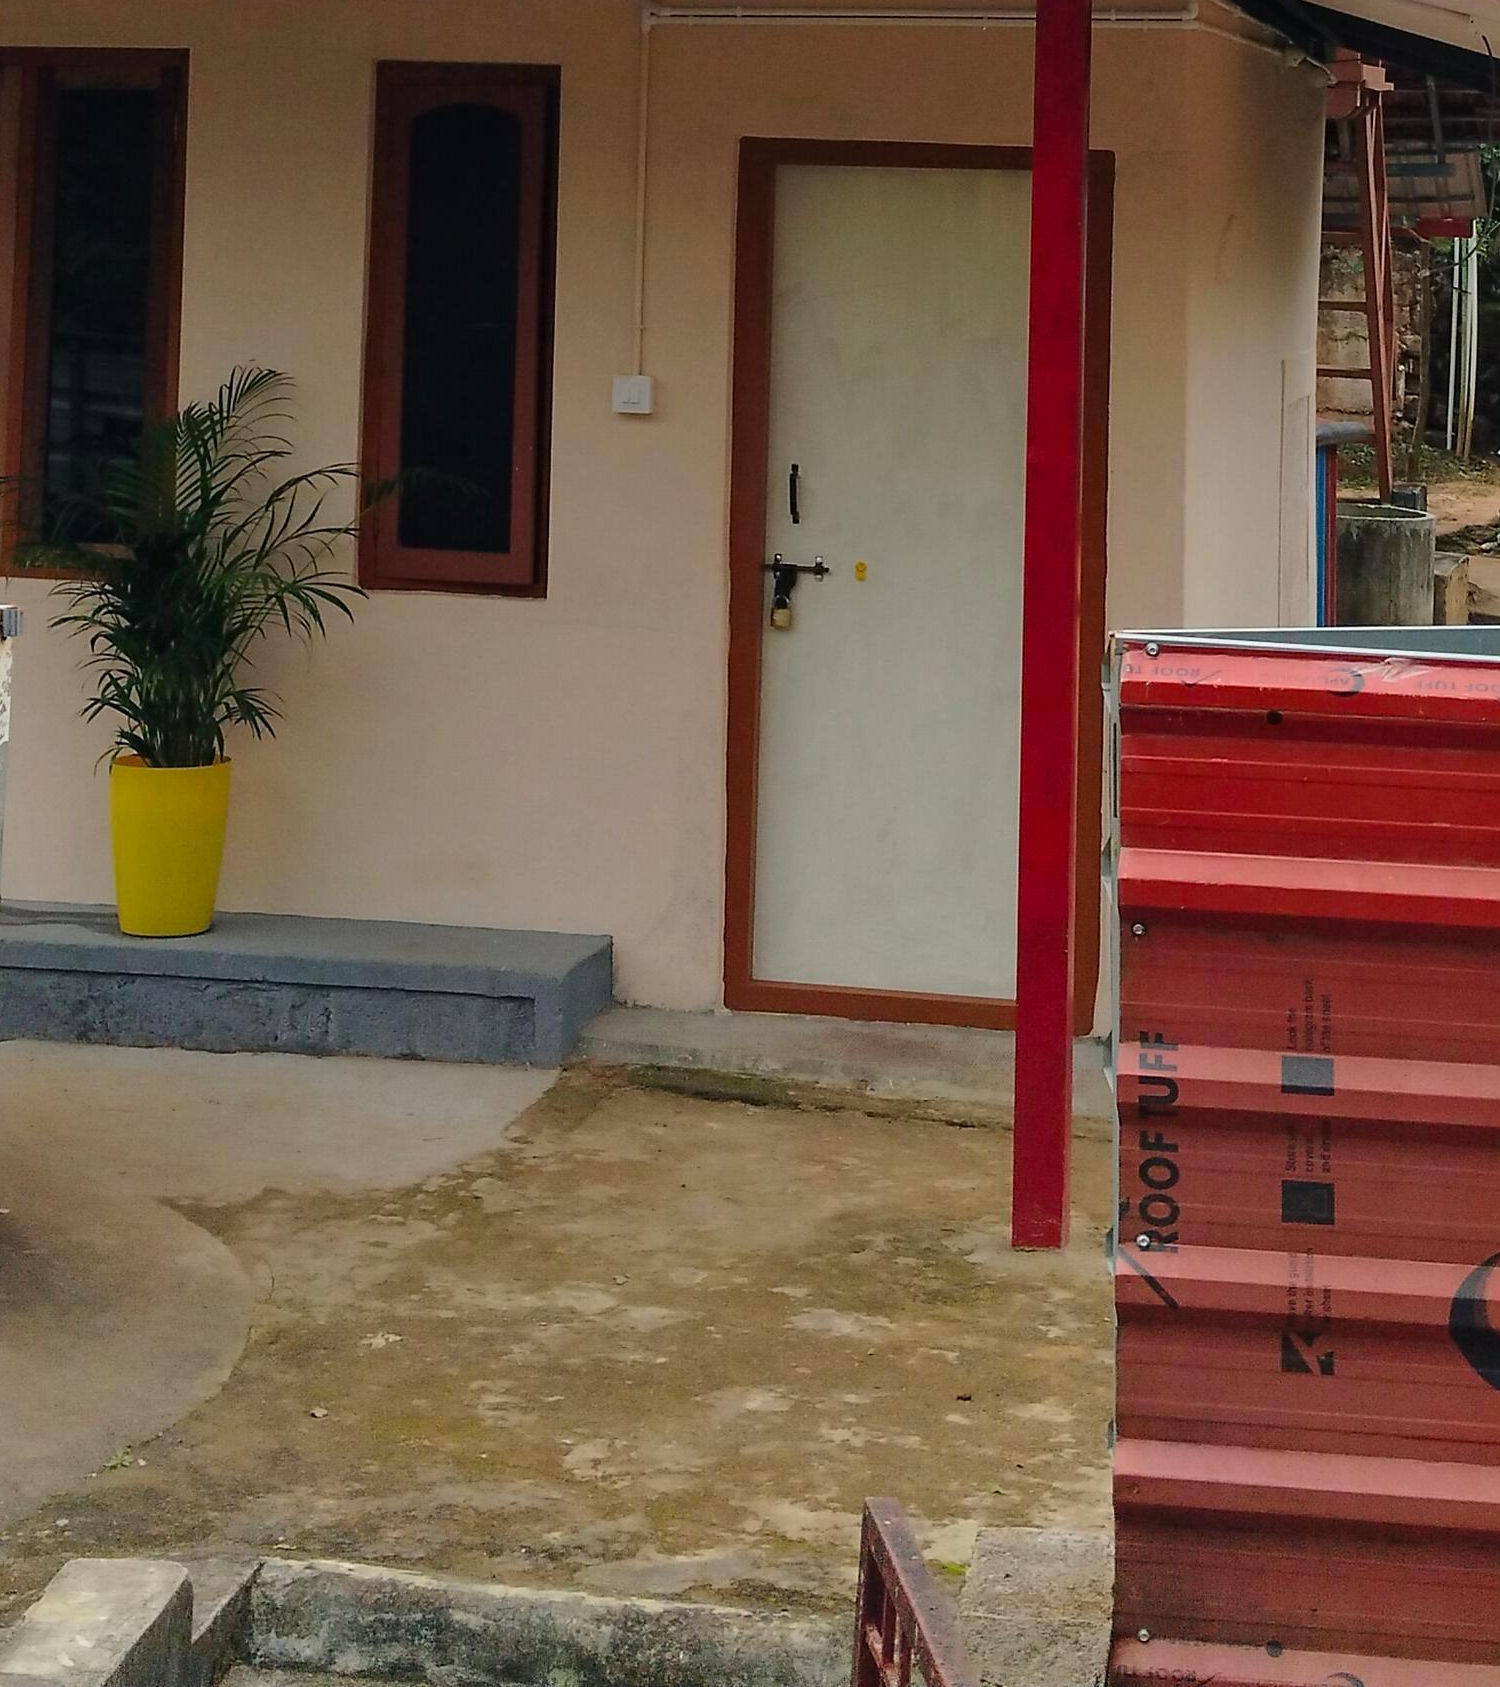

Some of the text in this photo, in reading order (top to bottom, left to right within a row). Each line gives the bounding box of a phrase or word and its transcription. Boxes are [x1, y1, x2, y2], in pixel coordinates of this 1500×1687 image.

[1415, 679, 1456, 691] TUFF
[1138, 1031, 1181, 1254] ROOF TUFF
